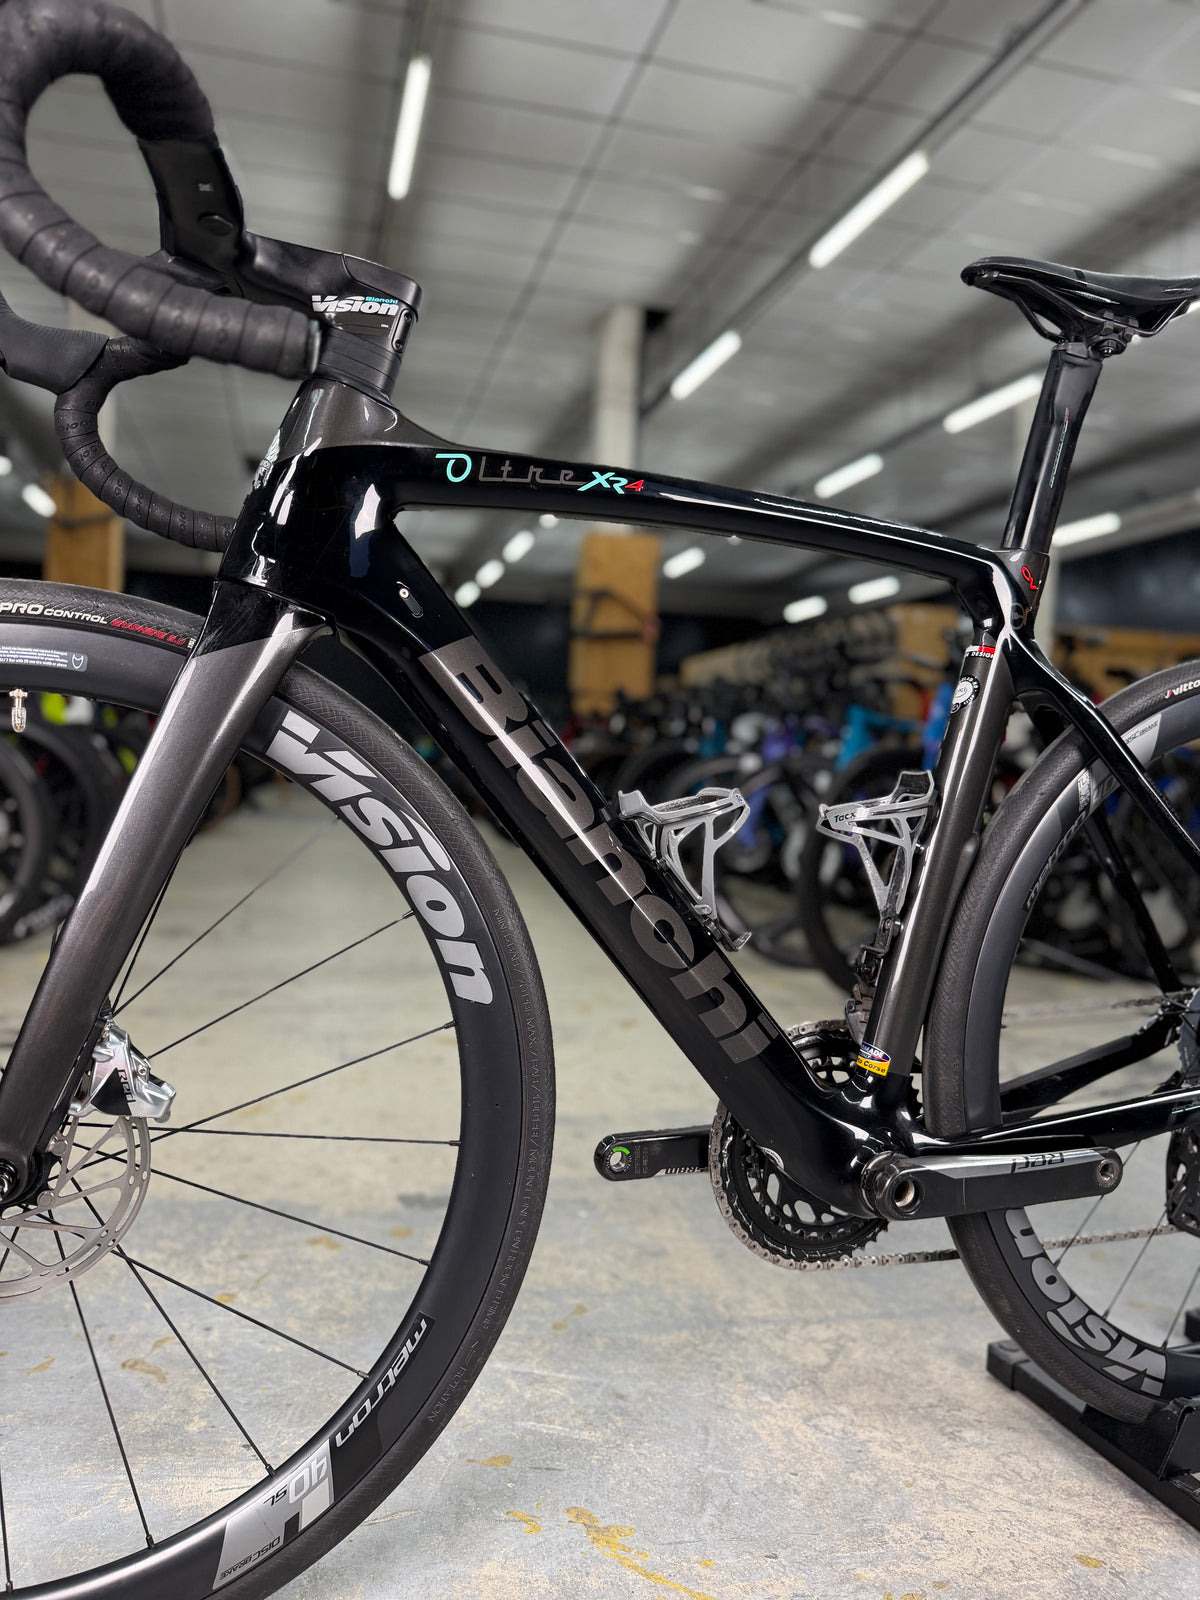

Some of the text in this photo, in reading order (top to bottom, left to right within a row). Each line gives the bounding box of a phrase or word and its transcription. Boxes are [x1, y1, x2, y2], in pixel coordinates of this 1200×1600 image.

[365, 296, 398, 304] Bianchi
[0, 602, 43, 615] PRO
[44, 608, 107, 624] CONTROL
[834, 811, 857, 822] Tacx
[418, 635, 778, 1064] Bianchi
[263, 1484, 287, 1506] SL
